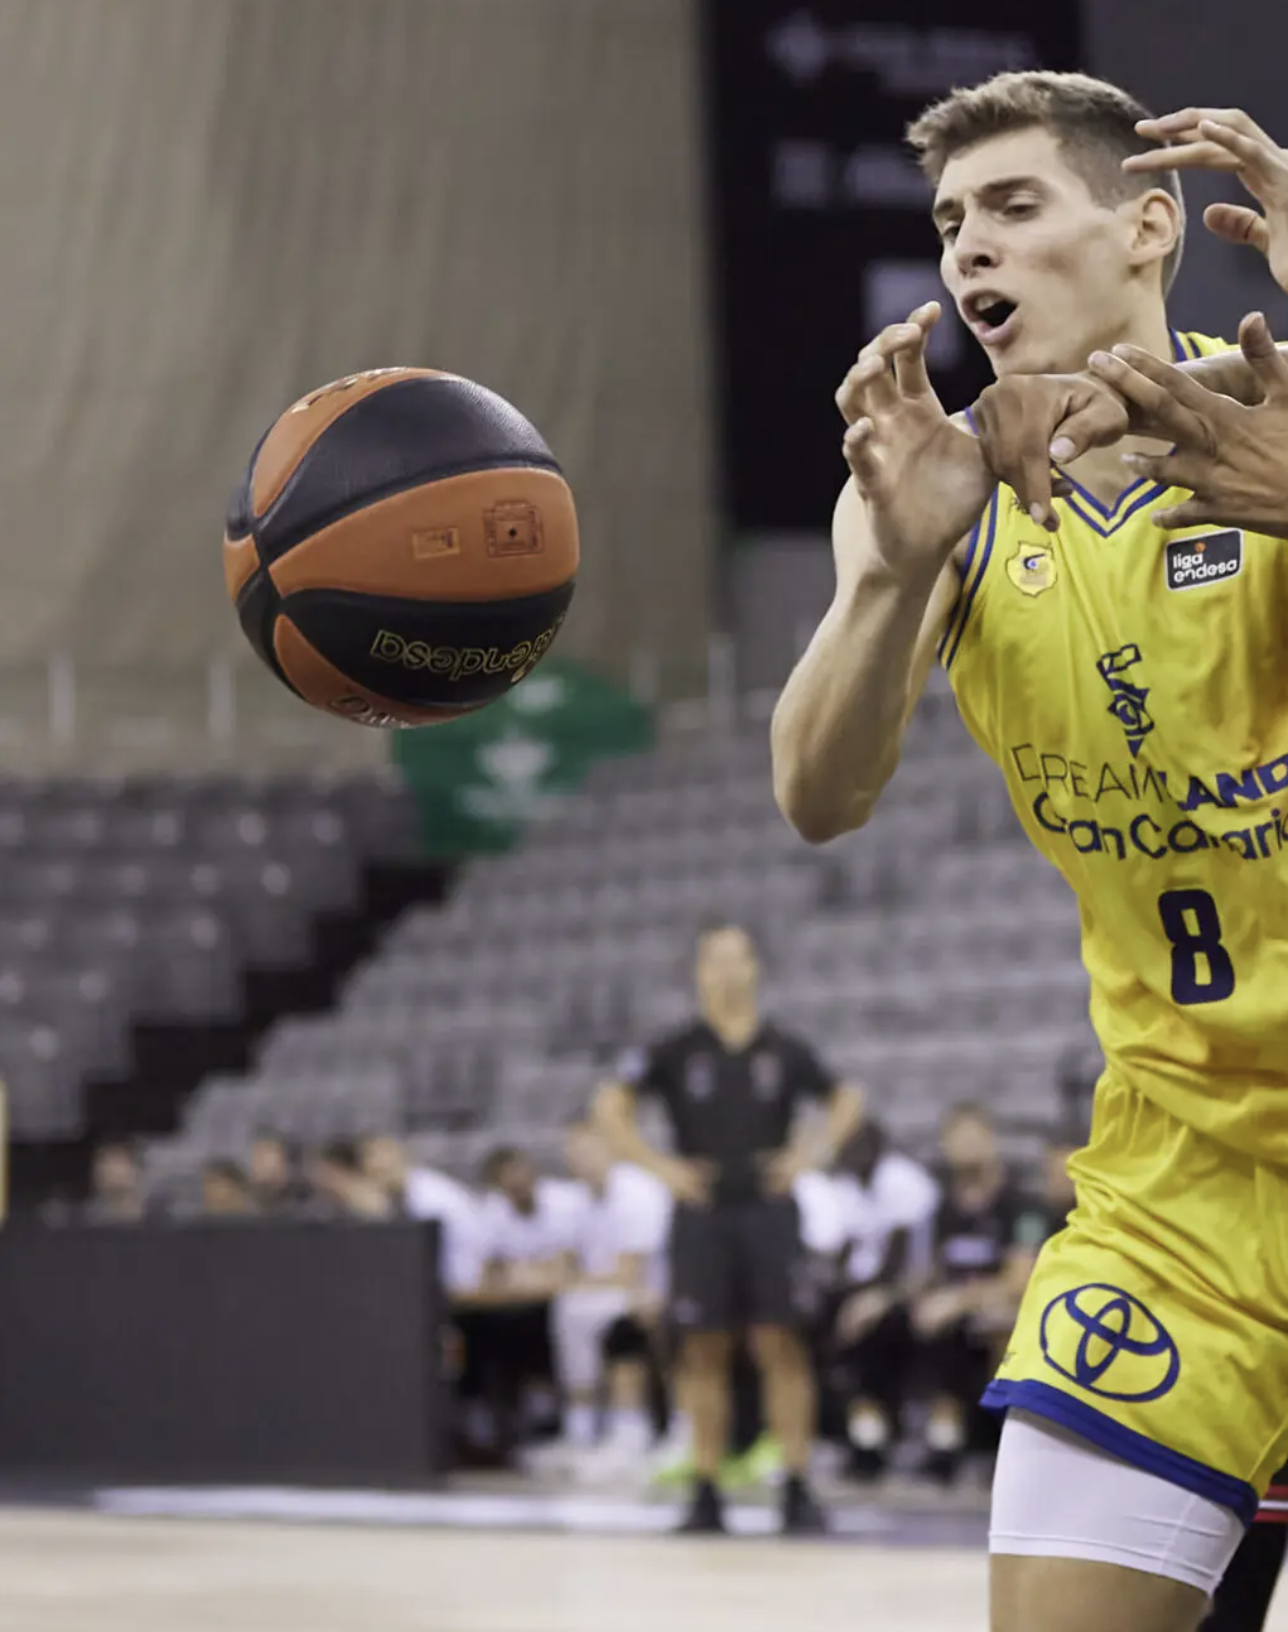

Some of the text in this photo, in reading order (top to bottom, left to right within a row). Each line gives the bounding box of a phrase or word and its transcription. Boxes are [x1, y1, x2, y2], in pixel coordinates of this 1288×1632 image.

[1172, 552, 1203, 570] liga
[1173, 559, 1238, 583] endesa
[369, 629, 531, 681] endesa
[1157, 889, 1236, 1005] 8
